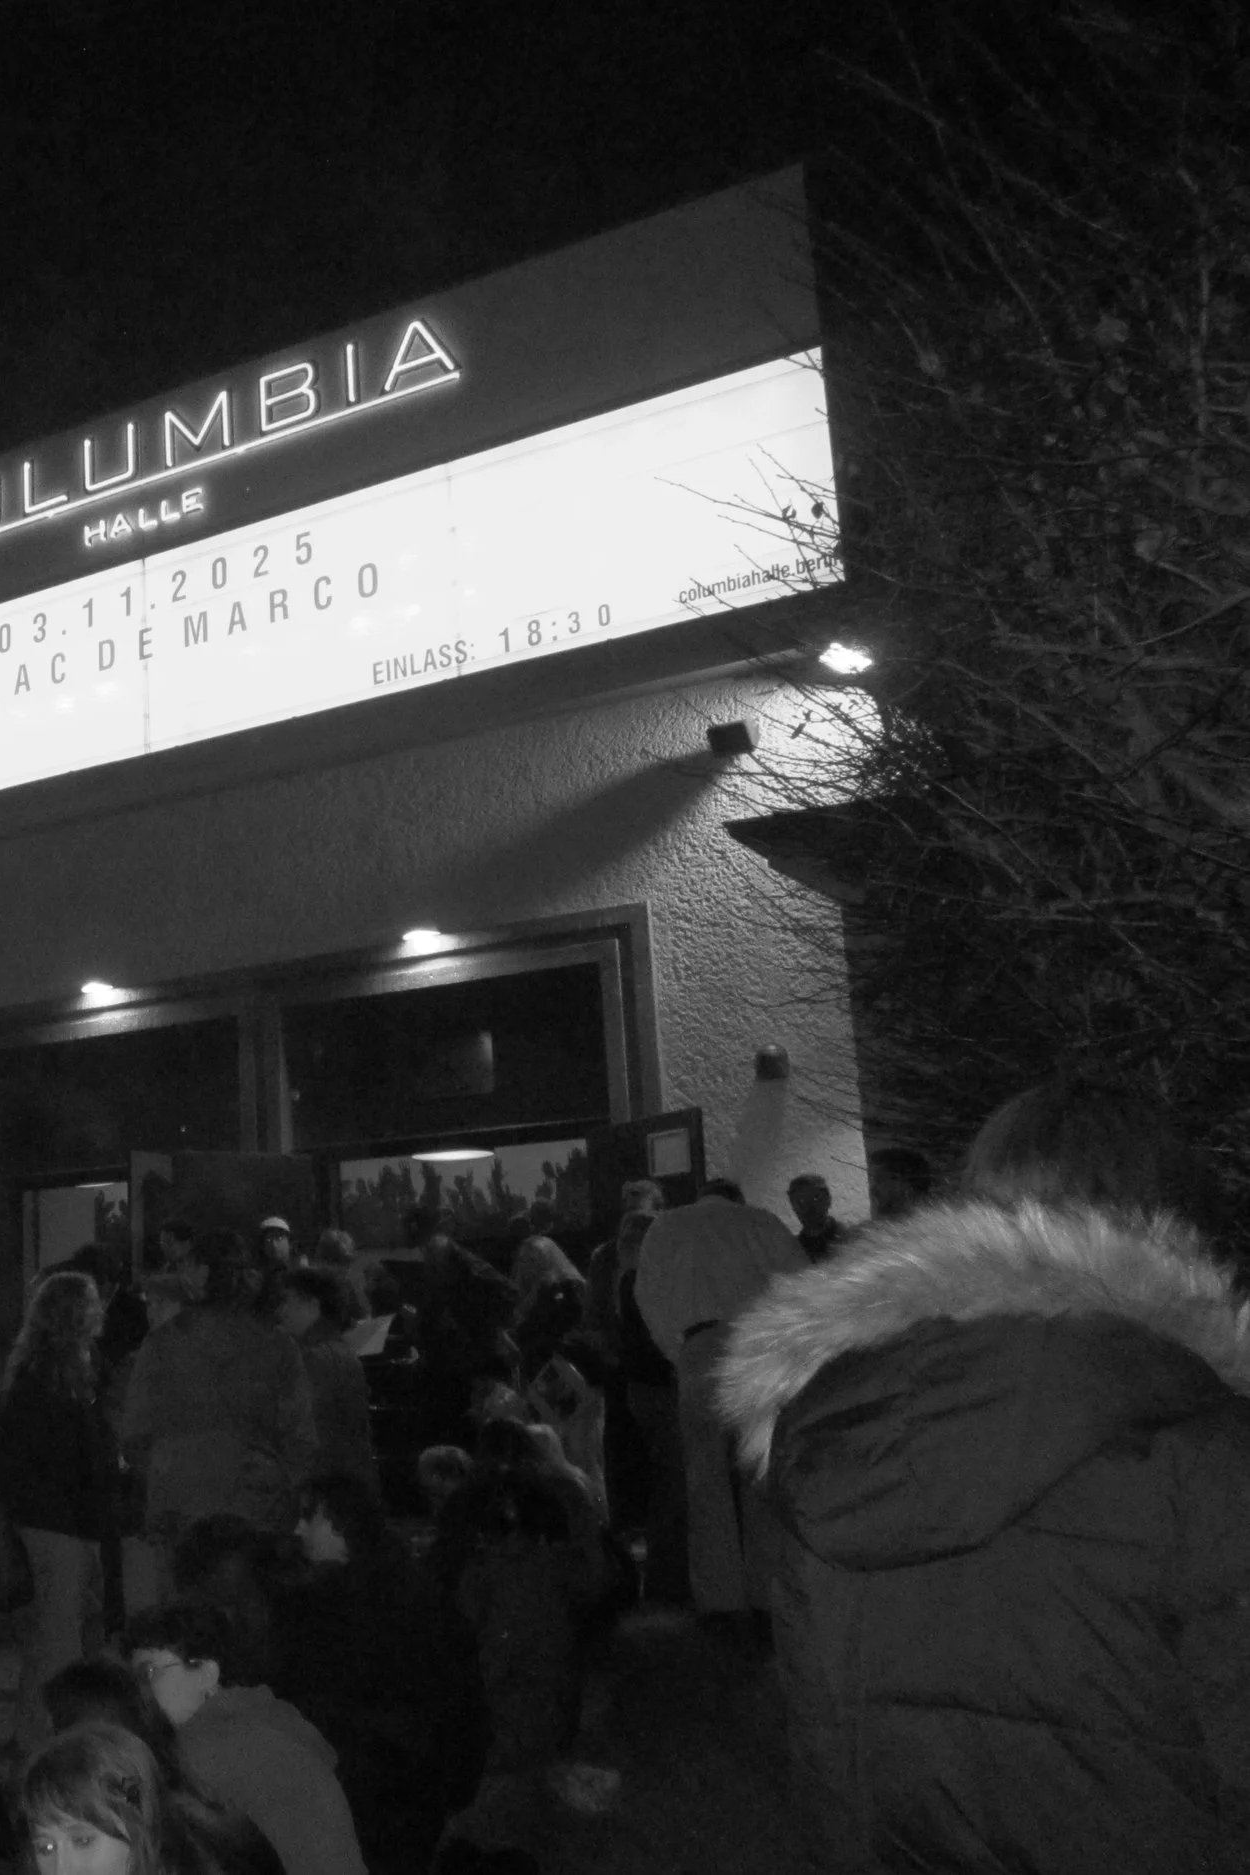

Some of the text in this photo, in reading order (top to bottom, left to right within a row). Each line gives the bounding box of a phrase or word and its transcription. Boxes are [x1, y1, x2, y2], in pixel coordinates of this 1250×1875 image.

[83, 487, 205, 547] HALLE
[97, 627, 154, 672] DE
[182, 562, 380, 649] MARCO
[371, 604, 612, 686] EINLASS: 18:30
